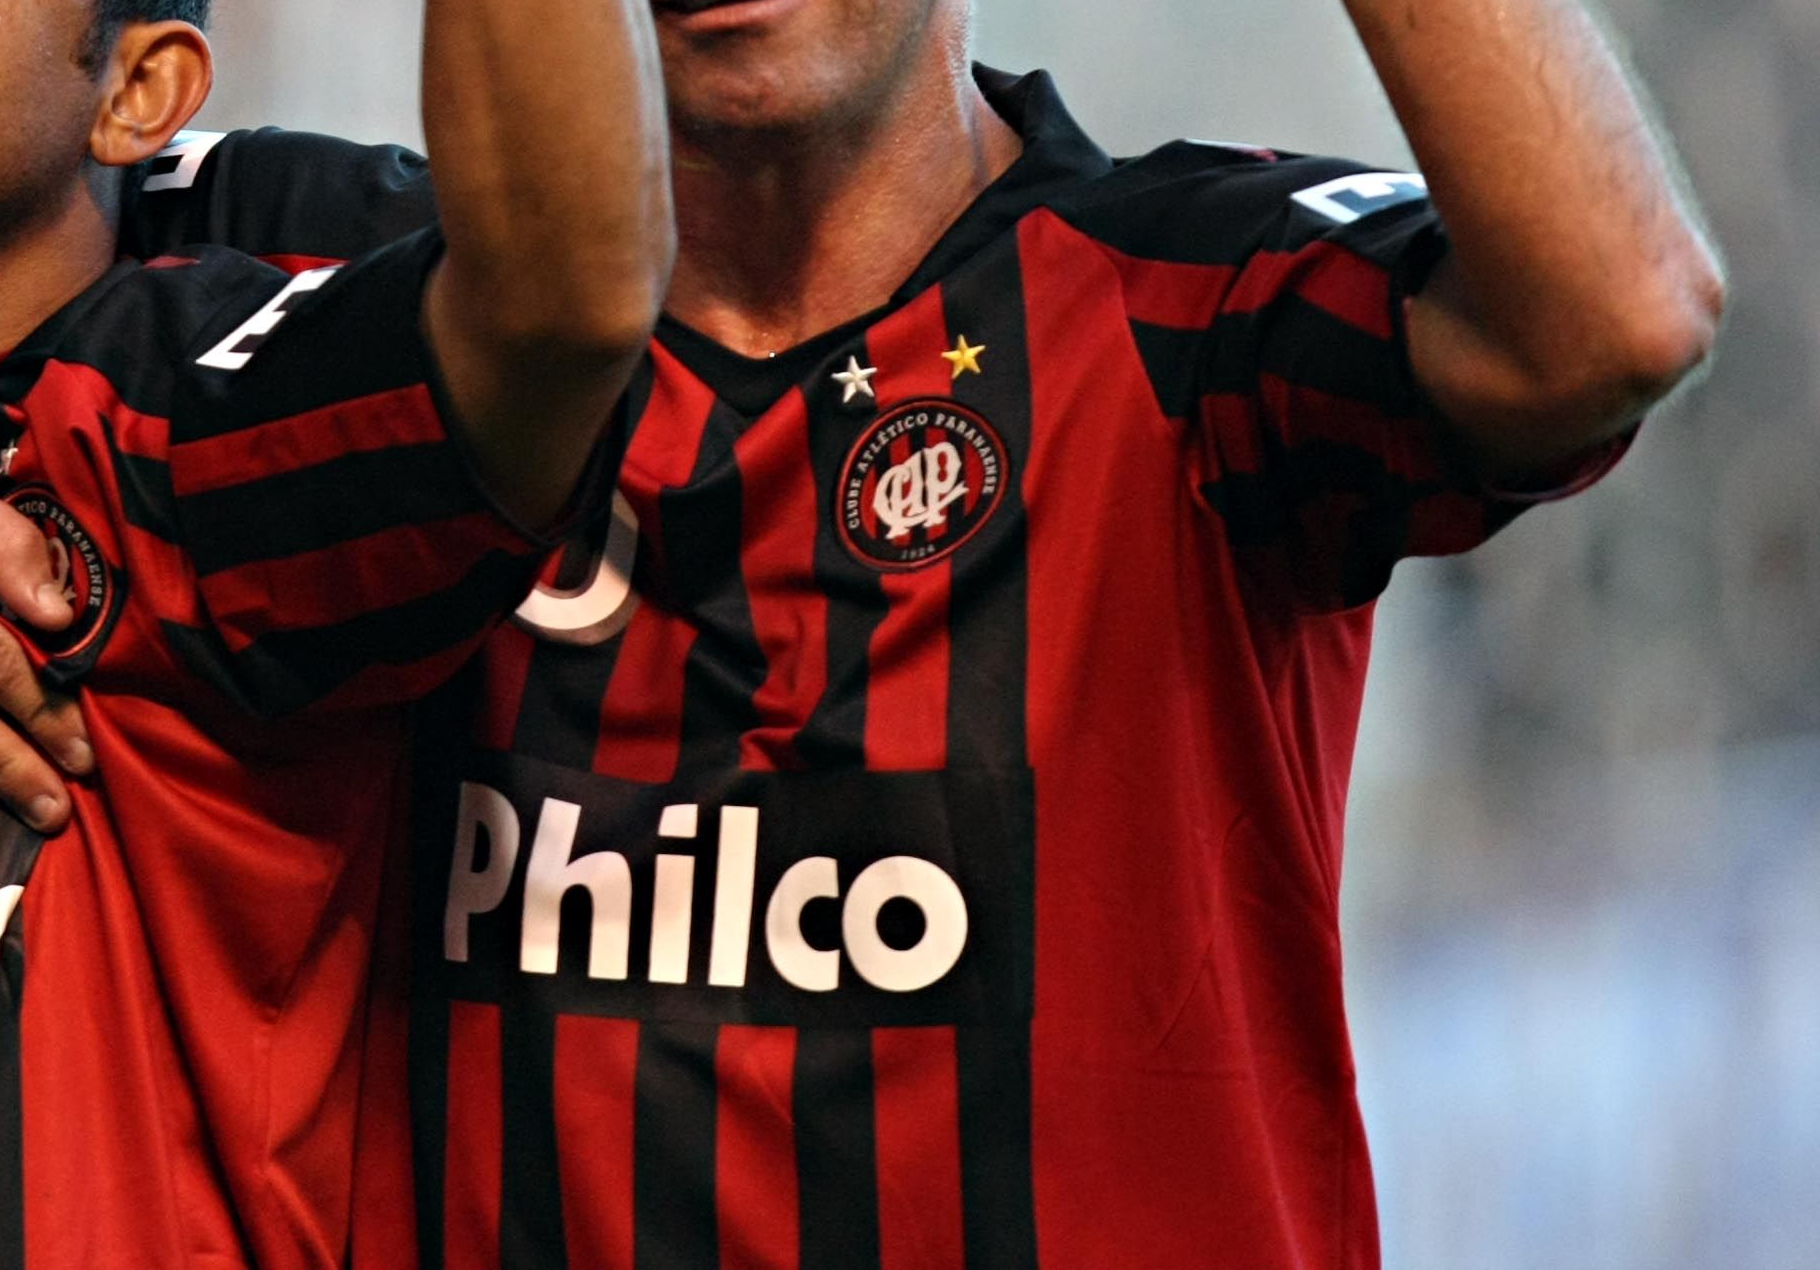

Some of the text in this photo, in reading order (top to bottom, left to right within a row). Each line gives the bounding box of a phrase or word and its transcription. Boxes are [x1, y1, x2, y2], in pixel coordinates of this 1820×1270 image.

[845, 478, 863, 530] CLUBE
[934, 412, 998, 495] PARANAENSE
[443, 781, 968, 992] Philco
